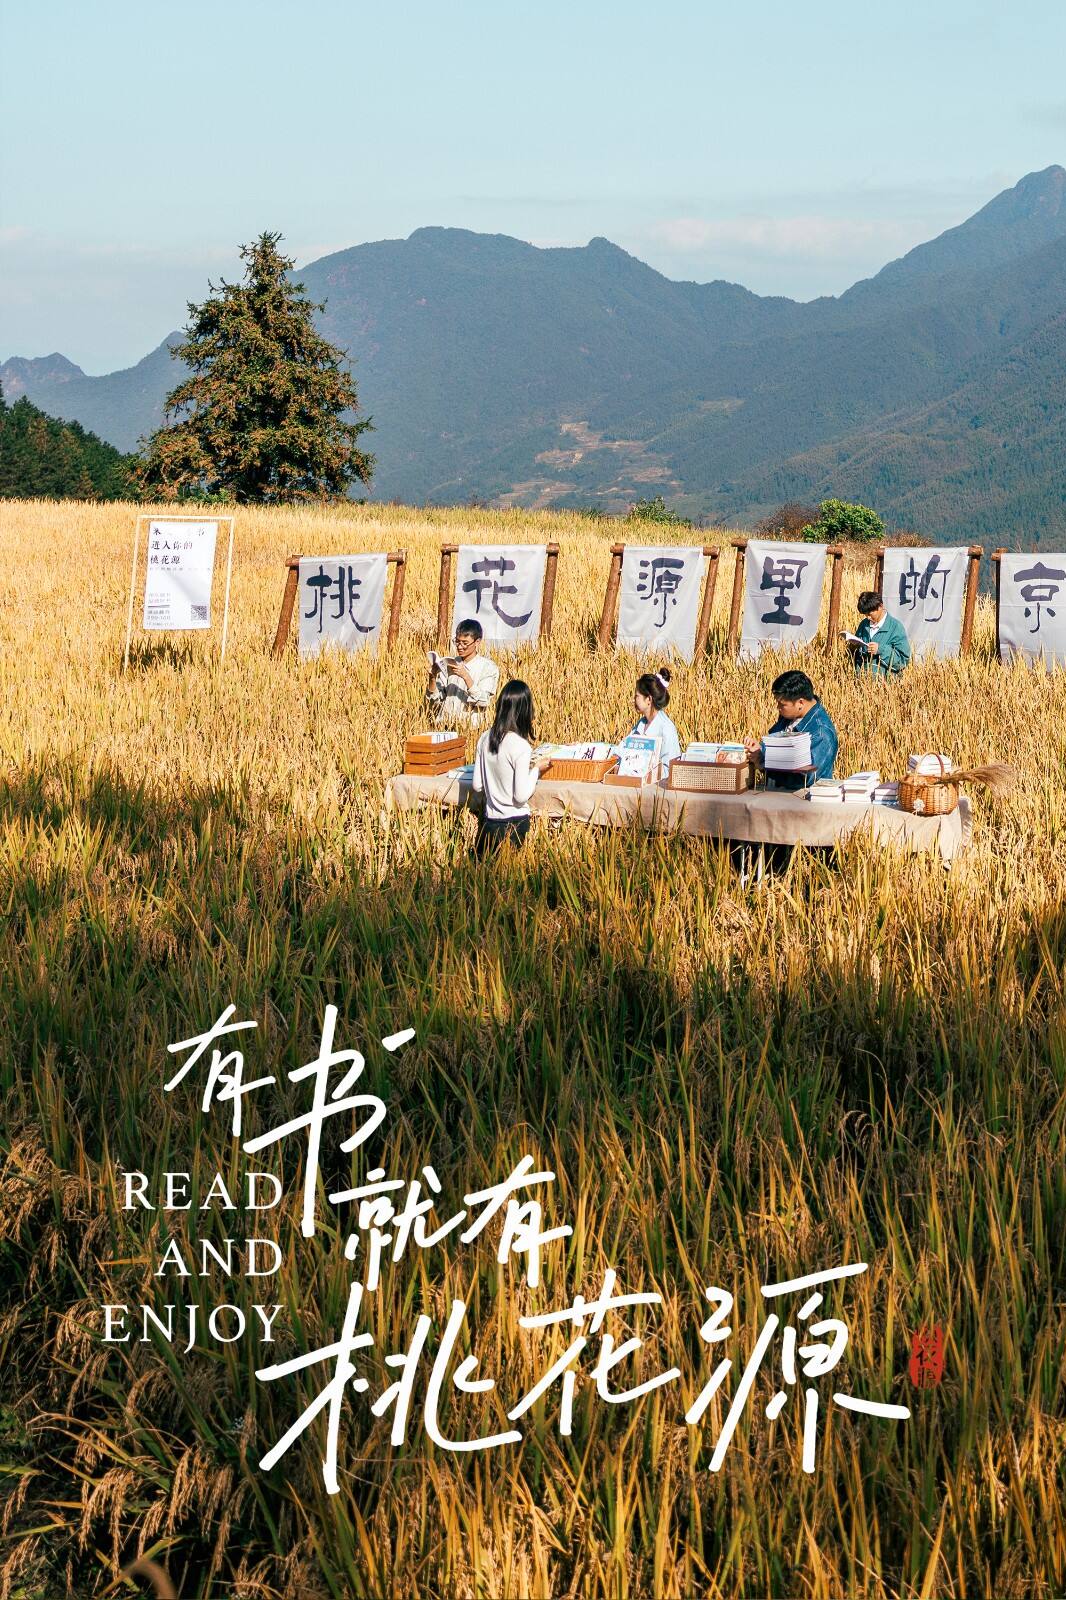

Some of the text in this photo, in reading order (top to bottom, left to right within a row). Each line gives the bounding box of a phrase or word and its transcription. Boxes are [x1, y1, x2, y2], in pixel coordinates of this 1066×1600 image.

[305, 564, 375, 634] 桃
[461, 556, 533, 627] 花
[636, 558, 684, 628] 源
[760, 556, 809, 626] 里
[899, 554, 951, 623] 的
[1013, 561, 1066, 634] 京
